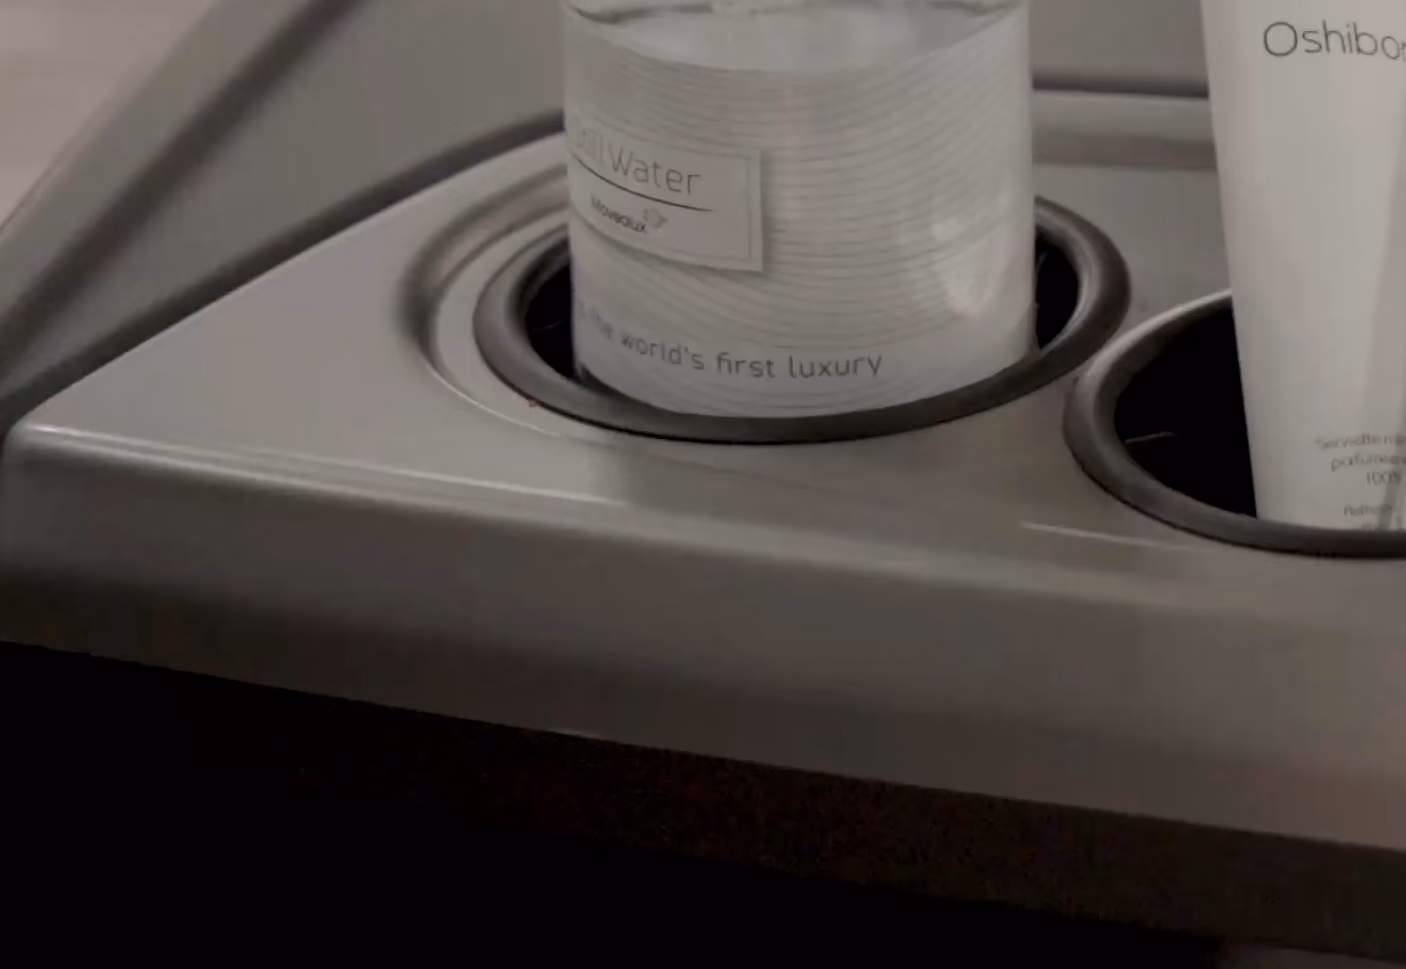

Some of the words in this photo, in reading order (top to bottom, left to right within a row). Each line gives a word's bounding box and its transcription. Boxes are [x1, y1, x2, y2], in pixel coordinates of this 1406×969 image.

[607, 141, 702, 195] Water
[617, 331, 706, 371] world's
[716, 351, 776, 379] first
[787, 354, 883, 379] luxury
